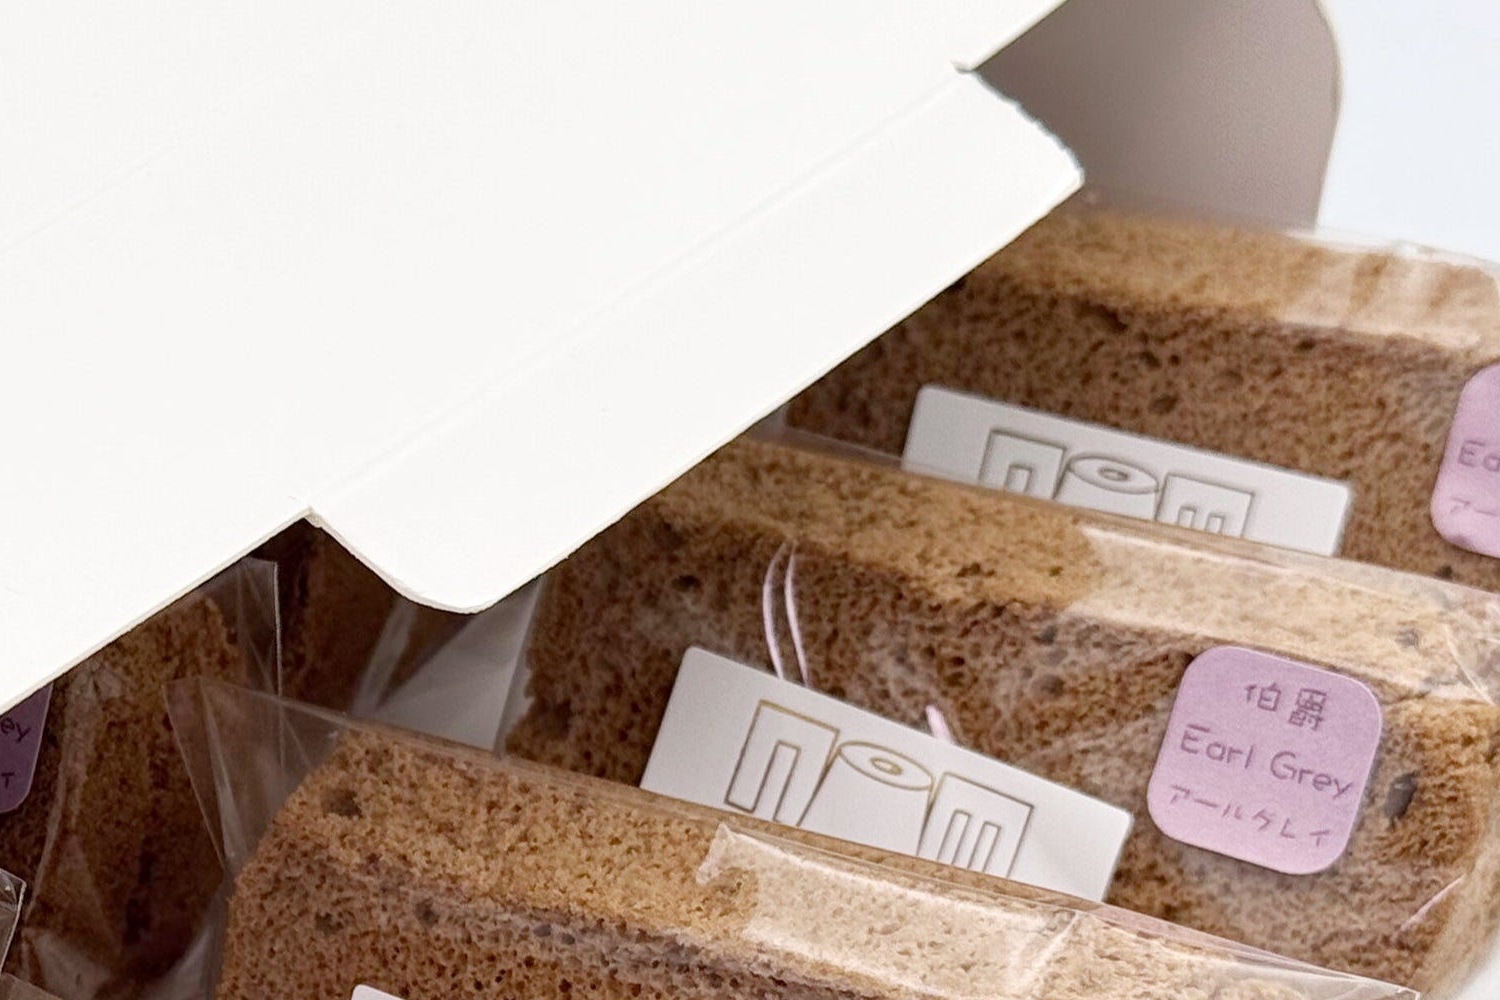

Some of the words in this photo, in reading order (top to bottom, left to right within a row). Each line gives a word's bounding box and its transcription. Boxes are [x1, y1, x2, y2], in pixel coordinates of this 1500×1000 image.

[0, 717, 32, 744] ey
[1244, 682, 1327, 732] 伯爵
[1180, 723, 1254, 769] Earl
[1270, 750, 1353, 800] Grey
[1170, 784, 1331, 847] アールグレイ
